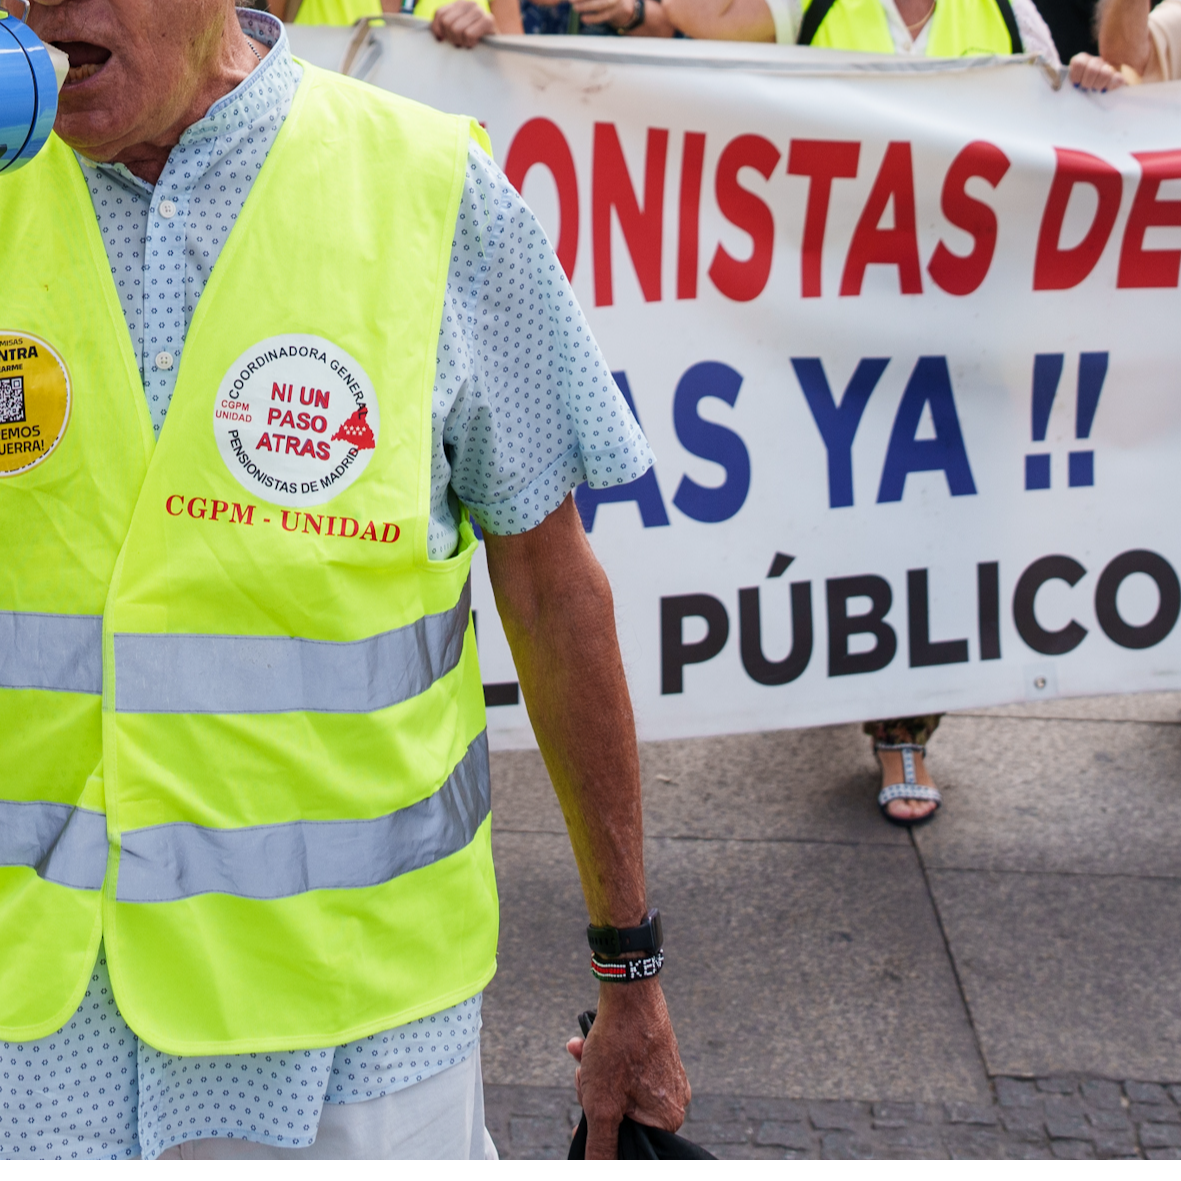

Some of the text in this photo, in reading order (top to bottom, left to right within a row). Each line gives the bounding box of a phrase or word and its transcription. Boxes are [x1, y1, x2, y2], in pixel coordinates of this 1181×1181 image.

[1033, 145, 1181, 291] DE
[221, 399, 250, 412] CGPM
[229, 346, 368, 420] COORDINADORA GENERAL
[271, 382, 331, 409] NI UN
[215, 410, 252, 423] UNIDAD
[267, 407, 328, 433] PASO
[789, 355, 978, 510] YA
[1024, 351, 1110, 491] !!
[228, 429, 359, 494] PENSIONISTAS DE MADRID
[255, 431, 331, 461] ATRAS
[165, 494, 256, 526] CGPM
[280, 509, 401, 544] UNIDAD
[660, 549, 1181, 696] PÚBLICO
